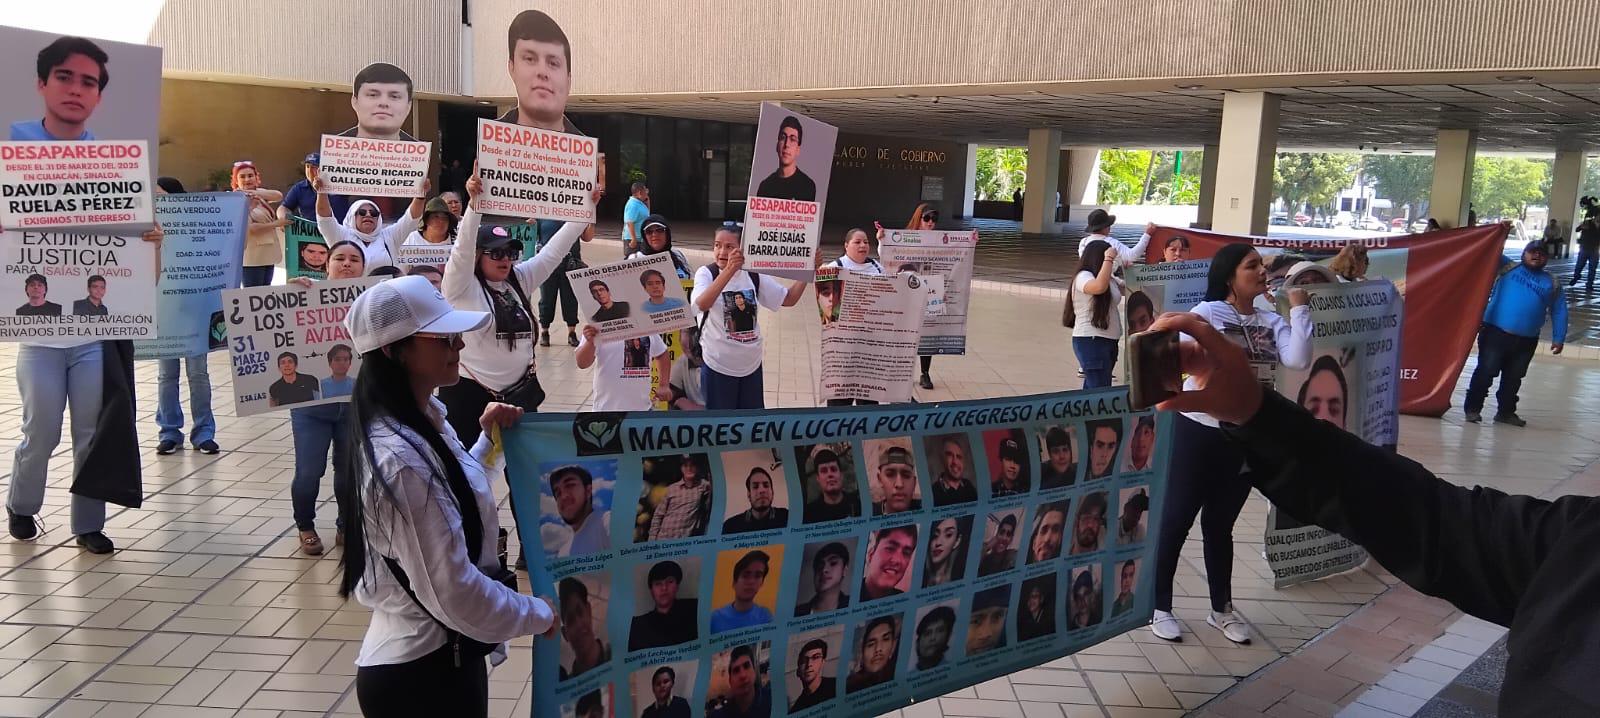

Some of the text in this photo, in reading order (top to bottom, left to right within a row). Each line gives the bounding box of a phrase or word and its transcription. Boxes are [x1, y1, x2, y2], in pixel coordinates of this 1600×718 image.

[325, 138, 427, 155] DESAPARECIDO
[482, 124, 594, 156] DESAPARECIDO
[1, 145, 142, 161] DESAPARECIDO
[481, 144, 593, 168] Desde el 27 de Noviembre de 2024
[834, 146, 946, 164] ACIO DE GOBIERNO
[6, 164, 33, 172] DESDE
[68, 162, 100, 170] MARZO
[102, 162, 116, 170] DEL
[118, 162, 140, 170] 2025
[321, 165, 424, 178] FRANCISCO RICARDO
[497, 159, 508, 168] EN
[550, 167, 580, 178] SINALOA
[24, 174, 36, 182] EN
[330, 176, 414, 187] GALLEGOS LÓPEZ
[480, 168, 593, 192] FRANCISCO RICARDO
[2, 181, 143, 198] DAVID ANTONIO
[490, 186, 584, 206] GALLEGOS LÓPEZ
[10, 194, 135, 214] RUELAS PÉREZ
[184, 206, 222, 214] VERDUGO
[539, 206, 550, 215] TU
[750, 198, 818, 216] DESAPARECIDO
[24, 216, 72, 226] EXIGIMOS
[74, 216, 86, 224] TU
[88, 214, 131, 223] REGRESO
[23, 231, 127, 248] EXIJIMOS
[758, 228, 806, 244] JOSÉ ISAÍAS
[16, 248, 119, 267] JUSTICIA
[400, 247, 445, 258] yudanos
[748, 244, 812, 258] IBARRA DUARTE
[408, 256, 445, 266] GONZALO
[584, 268, 601, 278] AÑO
[602, 256, 668, 274] DESAPARECIDOS
[6, 265, 132, 278] PARA ISAÍAS Y DAVID
[249, 291, 308, 312] DÓNDE
[1309, 292, 1388, 312] AYUDANOS A LOCALIZAR
[0, 314, 153, 327] STUDIANTES DE AVIACIÓN
[254, 306, 352, 332] LOS ESTUDI
[0, 326, 149, 338] RIVADOS DE LA LIVERTAD
[274, 326, 352, 349] DE AVIAC
[1318, 320, 1352, 338] EDUARDO
[233, 335, 256, 354] 31
[233, 351, 270, 368] MARZO
[237, 363, 267, 377] 2025
[629, 396, 1127, 452] MADRES EN LUCHA POR TU REGRESO A CASA A.C.
[1266, 532, 1306, 547] CUALQUIER
[1268, 552, 1280, 564] NO
[1280, 546, 1317, 562] BUSCAMOS
[1273, 561, 1323, 579] DESAPARECIDOS
